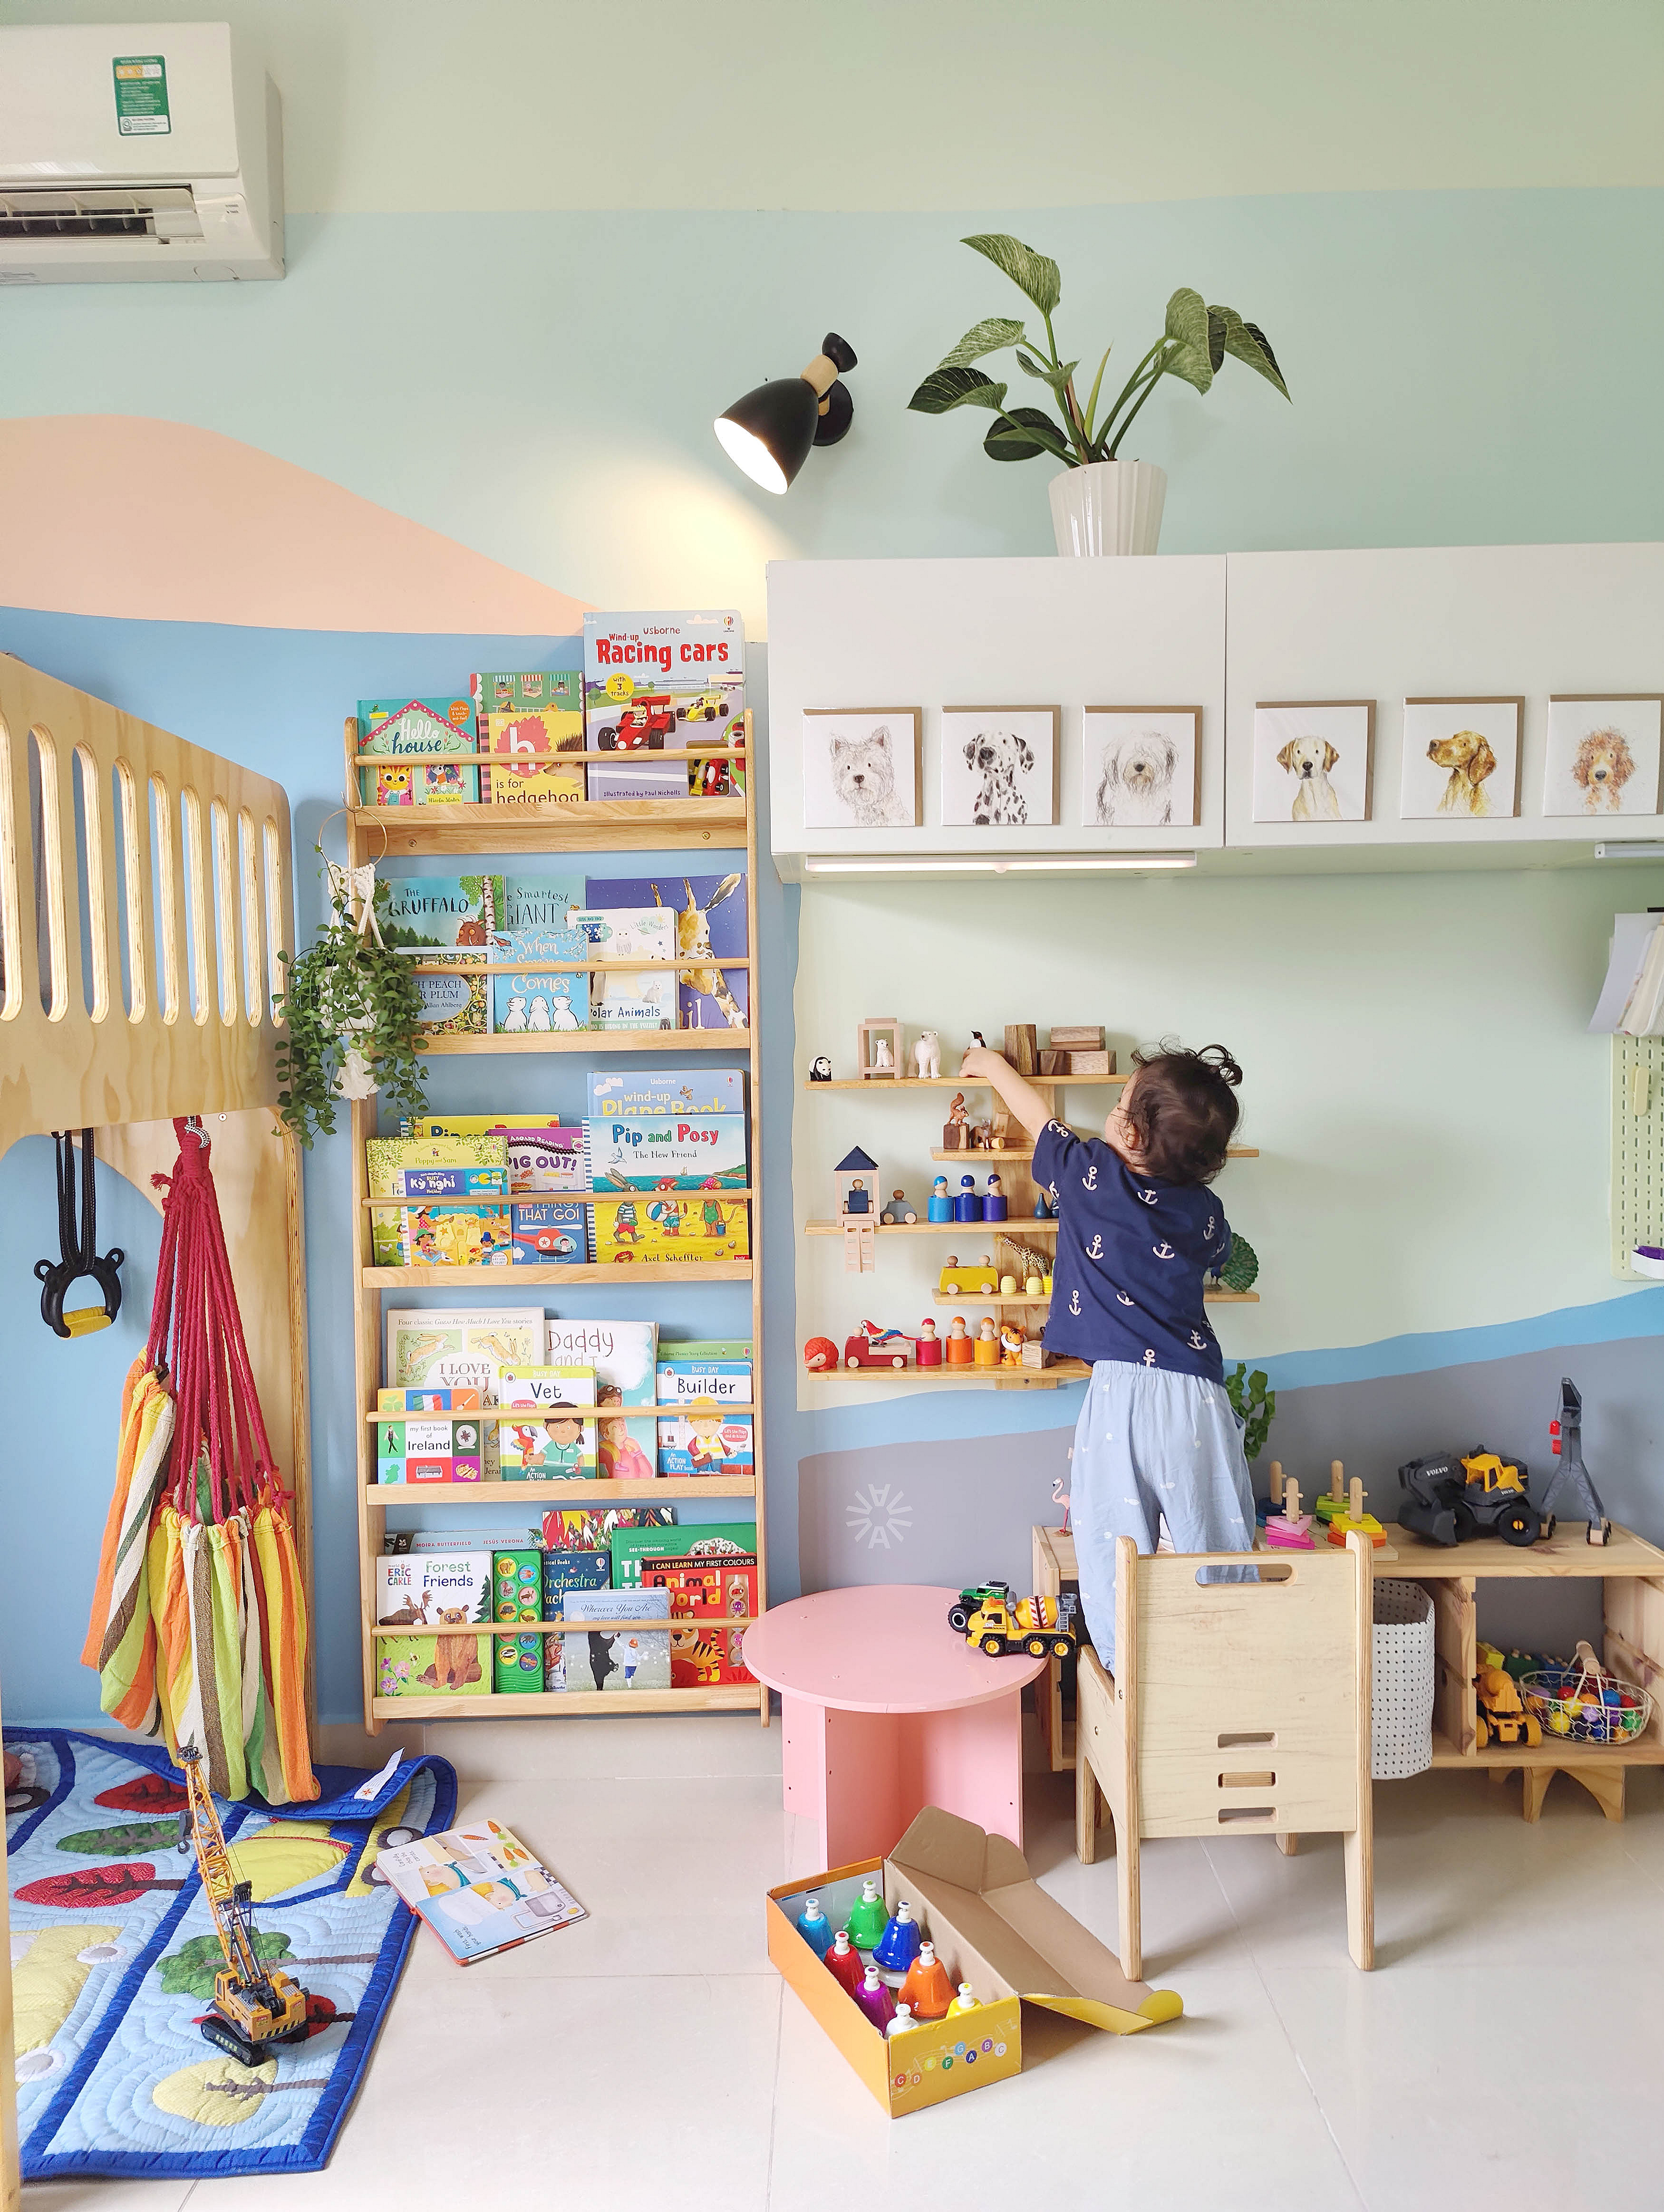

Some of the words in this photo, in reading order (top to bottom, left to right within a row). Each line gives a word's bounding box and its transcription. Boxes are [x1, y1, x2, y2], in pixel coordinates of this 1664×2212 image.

[609, 633, 639, 642] Wind-up
[596, 639, 671, 673] Racing
[680, 642, 728, 662] cars
[399, 718, 440, 741] Hello
[392, 732, 442, 754] house
[510, 727, 535, 770] h
[497, 779, 504, 789] is
[508, 779, 524, 788] for
[517, 887, 570, 903] Smartest
[388, 897, 469, 917] GRUFFALO
[518, 936, 559, 954] When
[512, 973, 570, 993] Comes
[591, 1008, 612, 1019] olar
[618, 1006, 660, 1018] Animals
[624, 1090, 671, 1105] wind-up
[612, 1124, 642, 1146] Pip
[648, 1130, 671, 1142] and
[677, 1124, 719, 1146] Posy
[633, 1150, 648, 1159] The
[672, 1150, 697, 1158] Friend
[536, 1156, 577, 1171] OUT!
[518, 1209, 547, 1221] THAT
[641, 1254, 660, 1262] Axel
[666, 1253, 704, 1262] Scheffler
[548, 1328, 613, 1357] Daddy
[555, 1352, 583, 1366] and
[440, 1363, 445, 1375] I
[449, 1363, 490, 1375] LOVE
[531, 1383, 561, 1399] Vet
[678, 1377, 736, 1394] Builder
[408, 1440, 450, 1450] Ireland
[1426, 1466, 1448, 1477] VOLVO
[388, 1568, 411, 1577] ERIC
[426, 1560, 471, 1573] Forest
[387, 1577, 412, 1586] CARLE
[424, 1575, 473, 1587] Friends
[654, 1570, 721, 1588] Animal
[581, 1604, 613, 1613] Wherever
[616, 1604, 633, 1615] You
[635, 1603, 651, 1612] Are
[898, 2076, 904, 2084] C
[914, 2075, 920, 2084] D
[928, 2059, 932, 2068] E
[945, 2059, 951, 2068] F
[968, 2053, 975, 2061] A
[999, 2046, 1004, 2054] C
